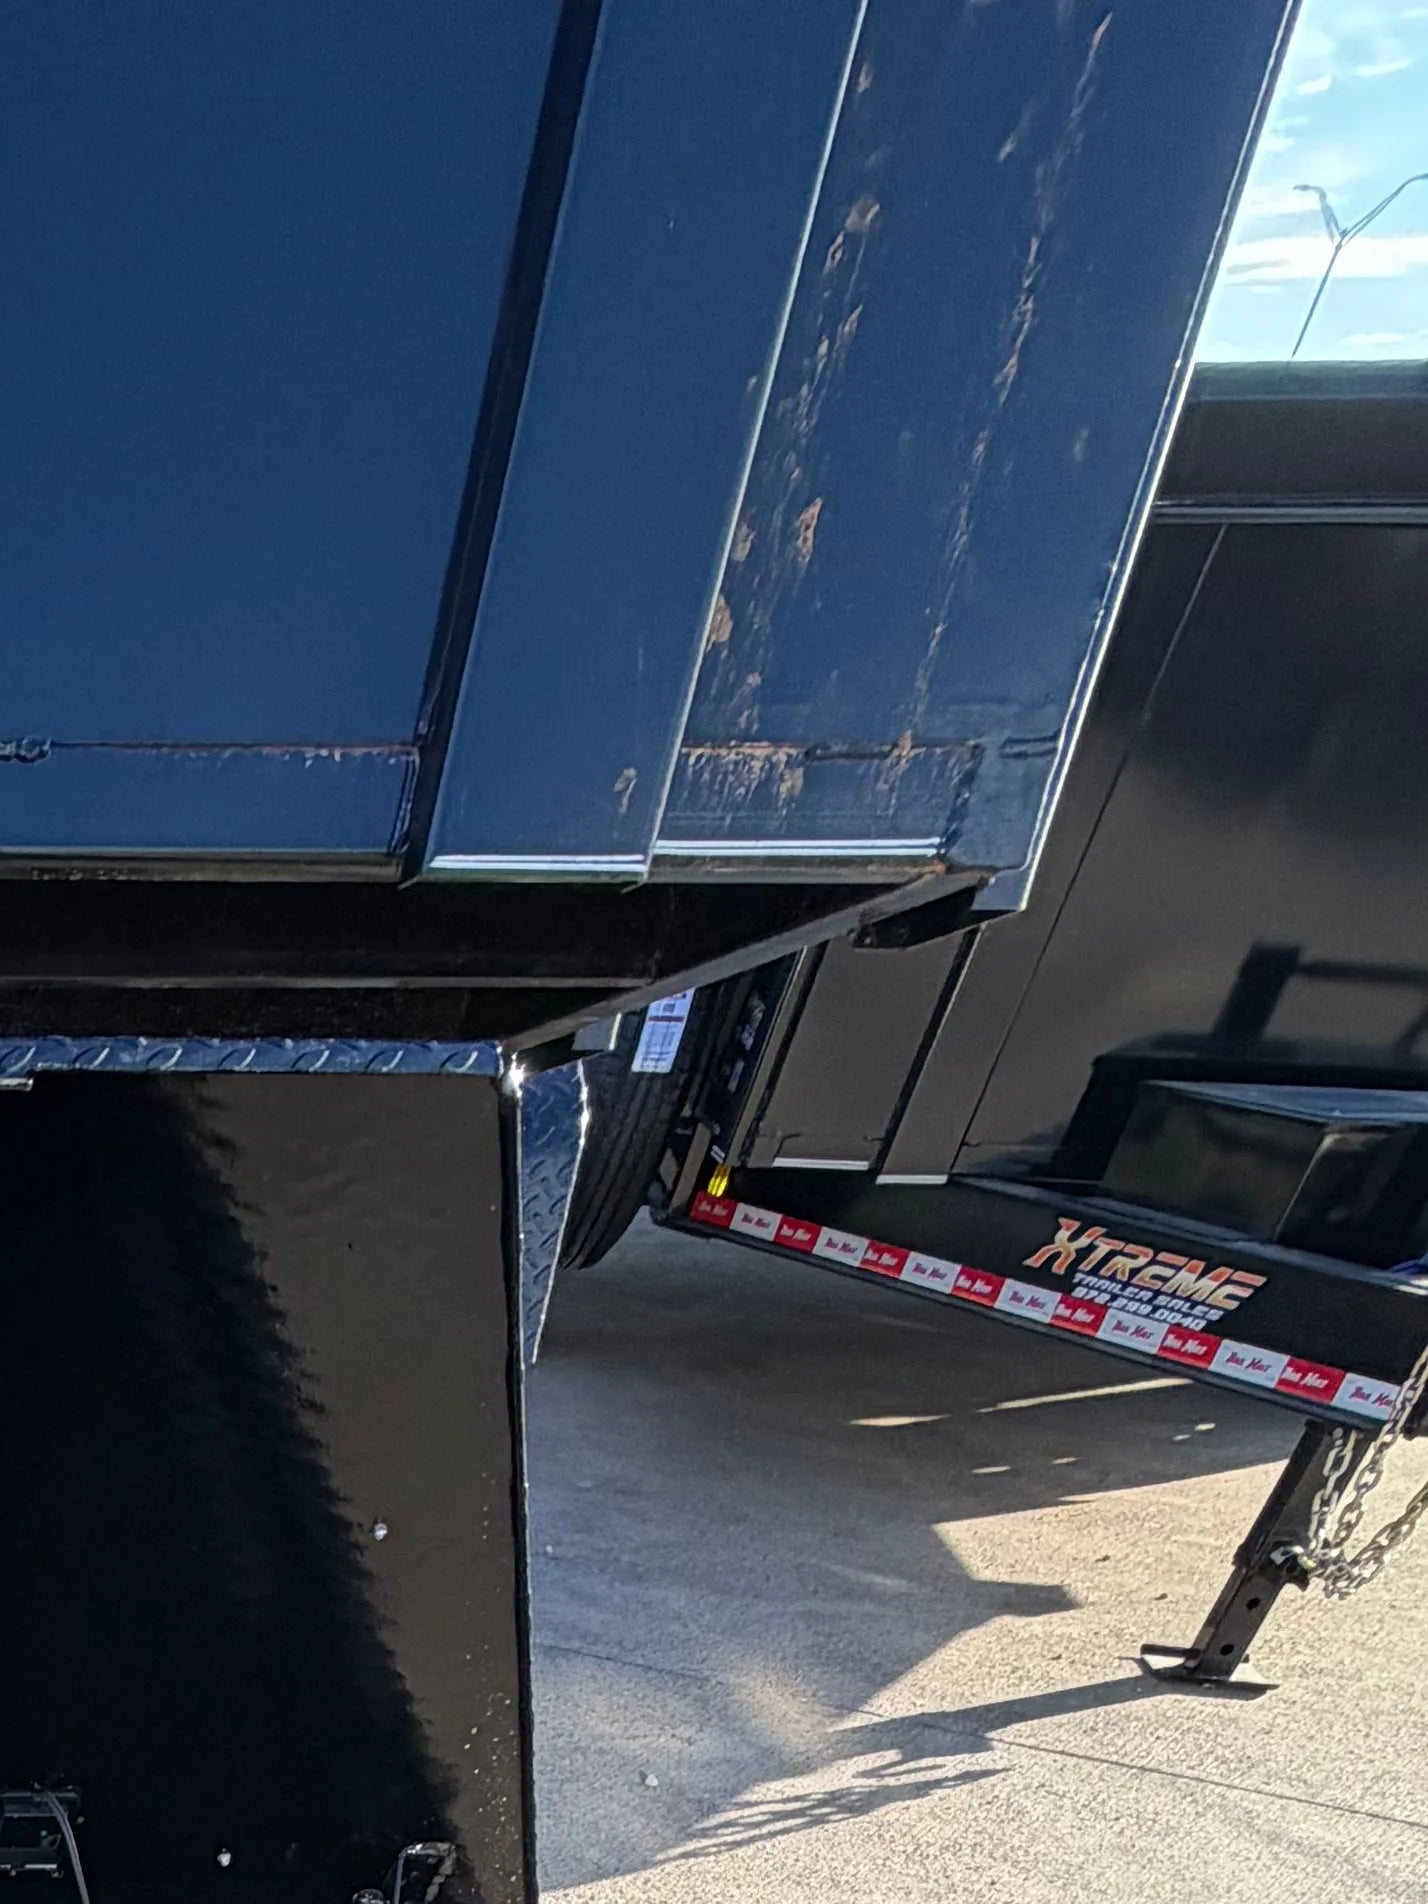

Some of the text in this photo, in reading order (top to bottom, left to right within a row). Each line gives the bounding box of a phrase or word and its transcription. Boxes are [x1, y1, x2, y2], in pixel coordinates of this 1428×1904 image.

[1022, 1217, 1268, 1311] XTREME
[1072, 1272, 1152, 1301] TRAILER
[1152, 1293, 1225, 1322] SALES
